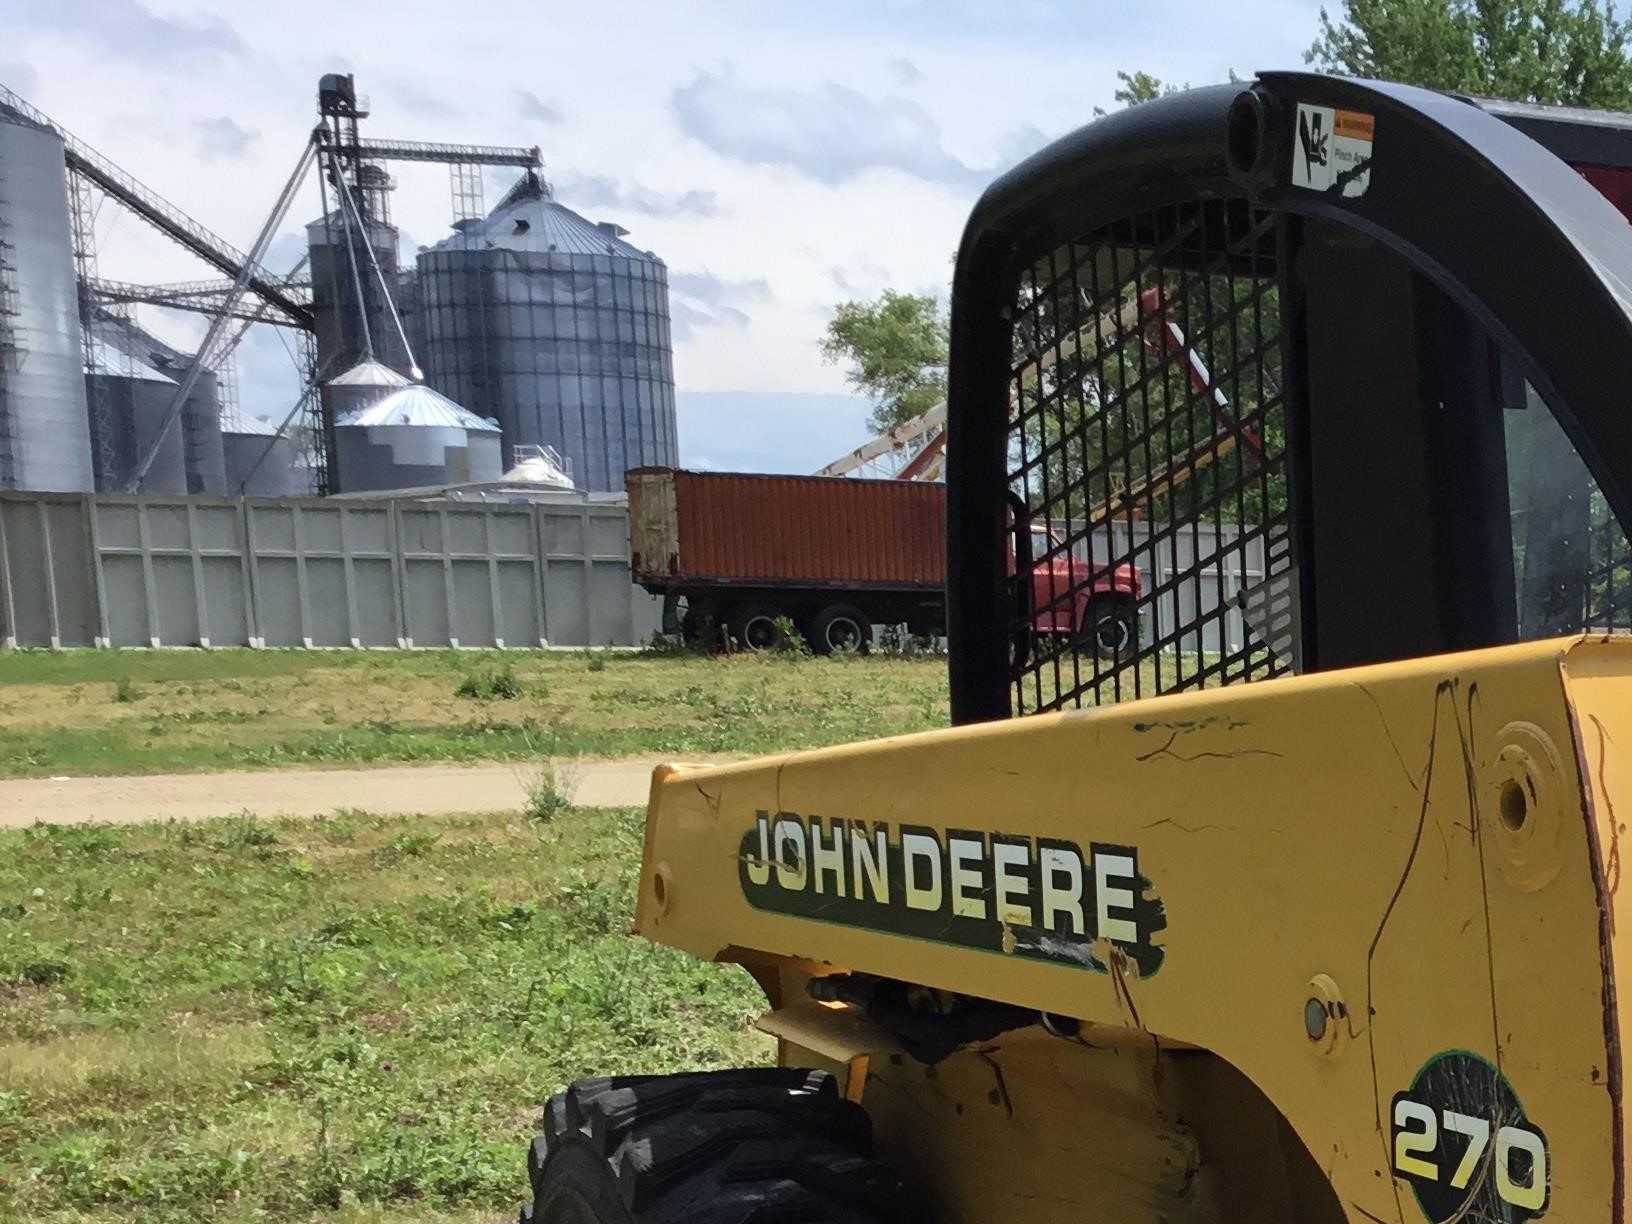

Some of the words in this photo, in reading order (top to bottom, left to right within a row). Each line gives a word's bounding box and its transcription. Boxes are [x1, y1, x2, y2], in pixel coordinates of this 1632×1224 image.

[1334, 147, 1353, 161] Pinch
[746, 817, 890, 905] JOHN
[901, 832, 1138, 943] DEERE
[1394, 1099, 1547, 1211] 270
